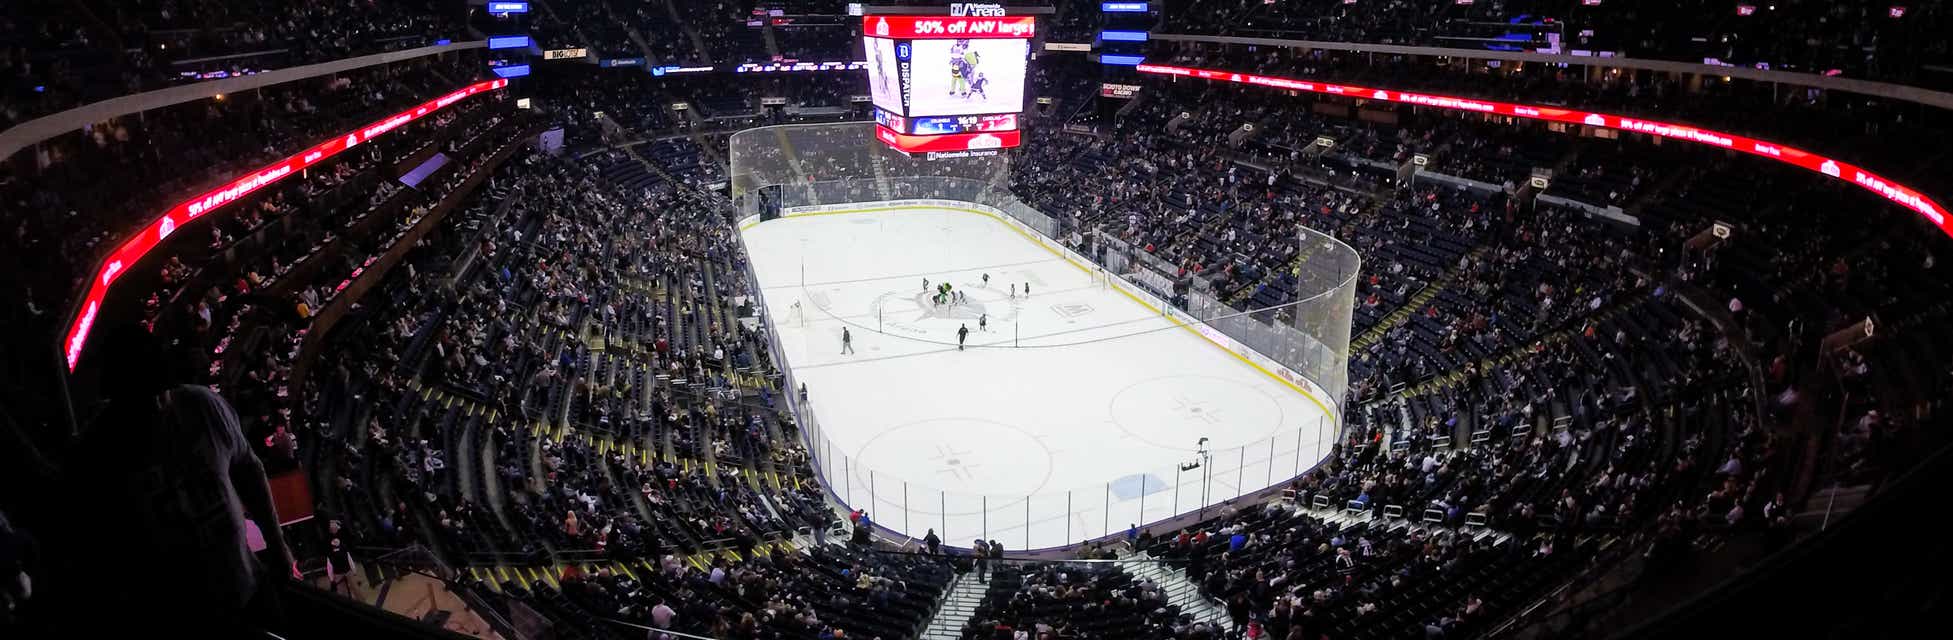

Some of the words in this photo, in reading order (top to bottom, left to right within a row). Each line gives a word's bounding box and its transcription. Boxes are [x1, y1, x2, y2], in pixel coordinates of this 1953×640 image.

[963, 3, 1006, 16] Arena
[915, 21, 944, 33] 50%
[947, 21, 968, 33] off
[968, 21, 996, 33] ANY
[998, 20, 1028, 36] large
[901, 62, 910, 107] DISPATCH
[936, 151, 970, 159] Nationwide
[971, 149, 998, 157] Insurance
